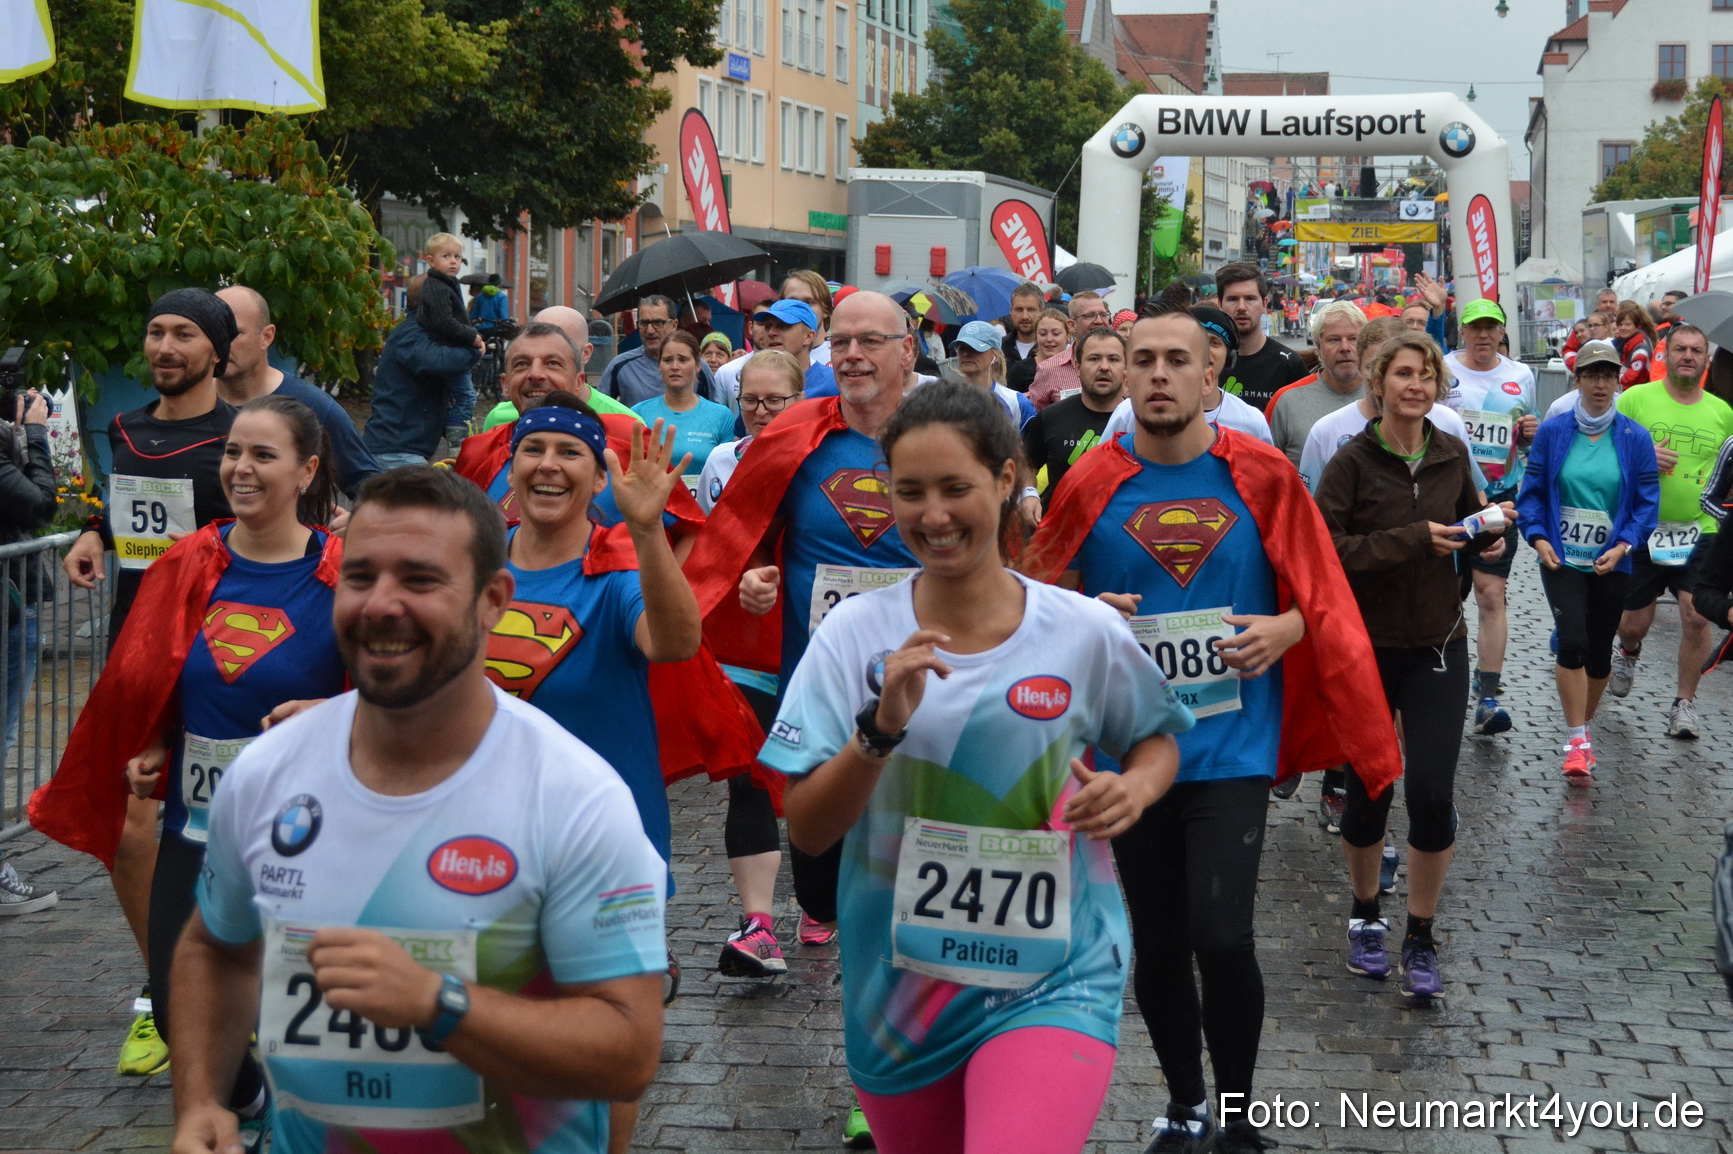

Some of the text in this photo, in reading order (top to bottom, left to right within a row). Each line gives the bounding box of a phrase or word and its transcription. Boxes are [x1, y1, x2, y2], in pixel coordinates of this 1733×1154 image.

[1158, 107, 1426, 141] BMW Laufsport
[1351, 226, 1382, 239] ZIEL
[1472, 206, 1495, 293] REWE
[1239, 390, 1273, 398] ORMANC
[1472, 446, 1493, 456] Erwin
[142, 481, 184, 494] BOCK
[131, 500, 168, 535] 59
[1560, 519, 1607, 545] 2476
[1653, 526, 1699, 549] 2122
[125, 542, 168, 558] Stepha
[1565, 547, 1593, 558] Sabine
[1132, 627, 1161, 635] uerMarkt
[1166, 612, 1223, 631] BOCK
[1016, 686, 1067, 709] Hervis
[1176, 691, 1199, 706] ax
[915, 837, 969, 854] NeuerMarkt
[979, 833, 1058, 856] BOCK
[261, 864, 307, 887] PARTL
[439, 848, 508, 880] Hervis
[913, 860, 1057, 930] 2470
[941, 936, 1019, 966] Paticia
[346, 1070, 392, 1099] Roi
